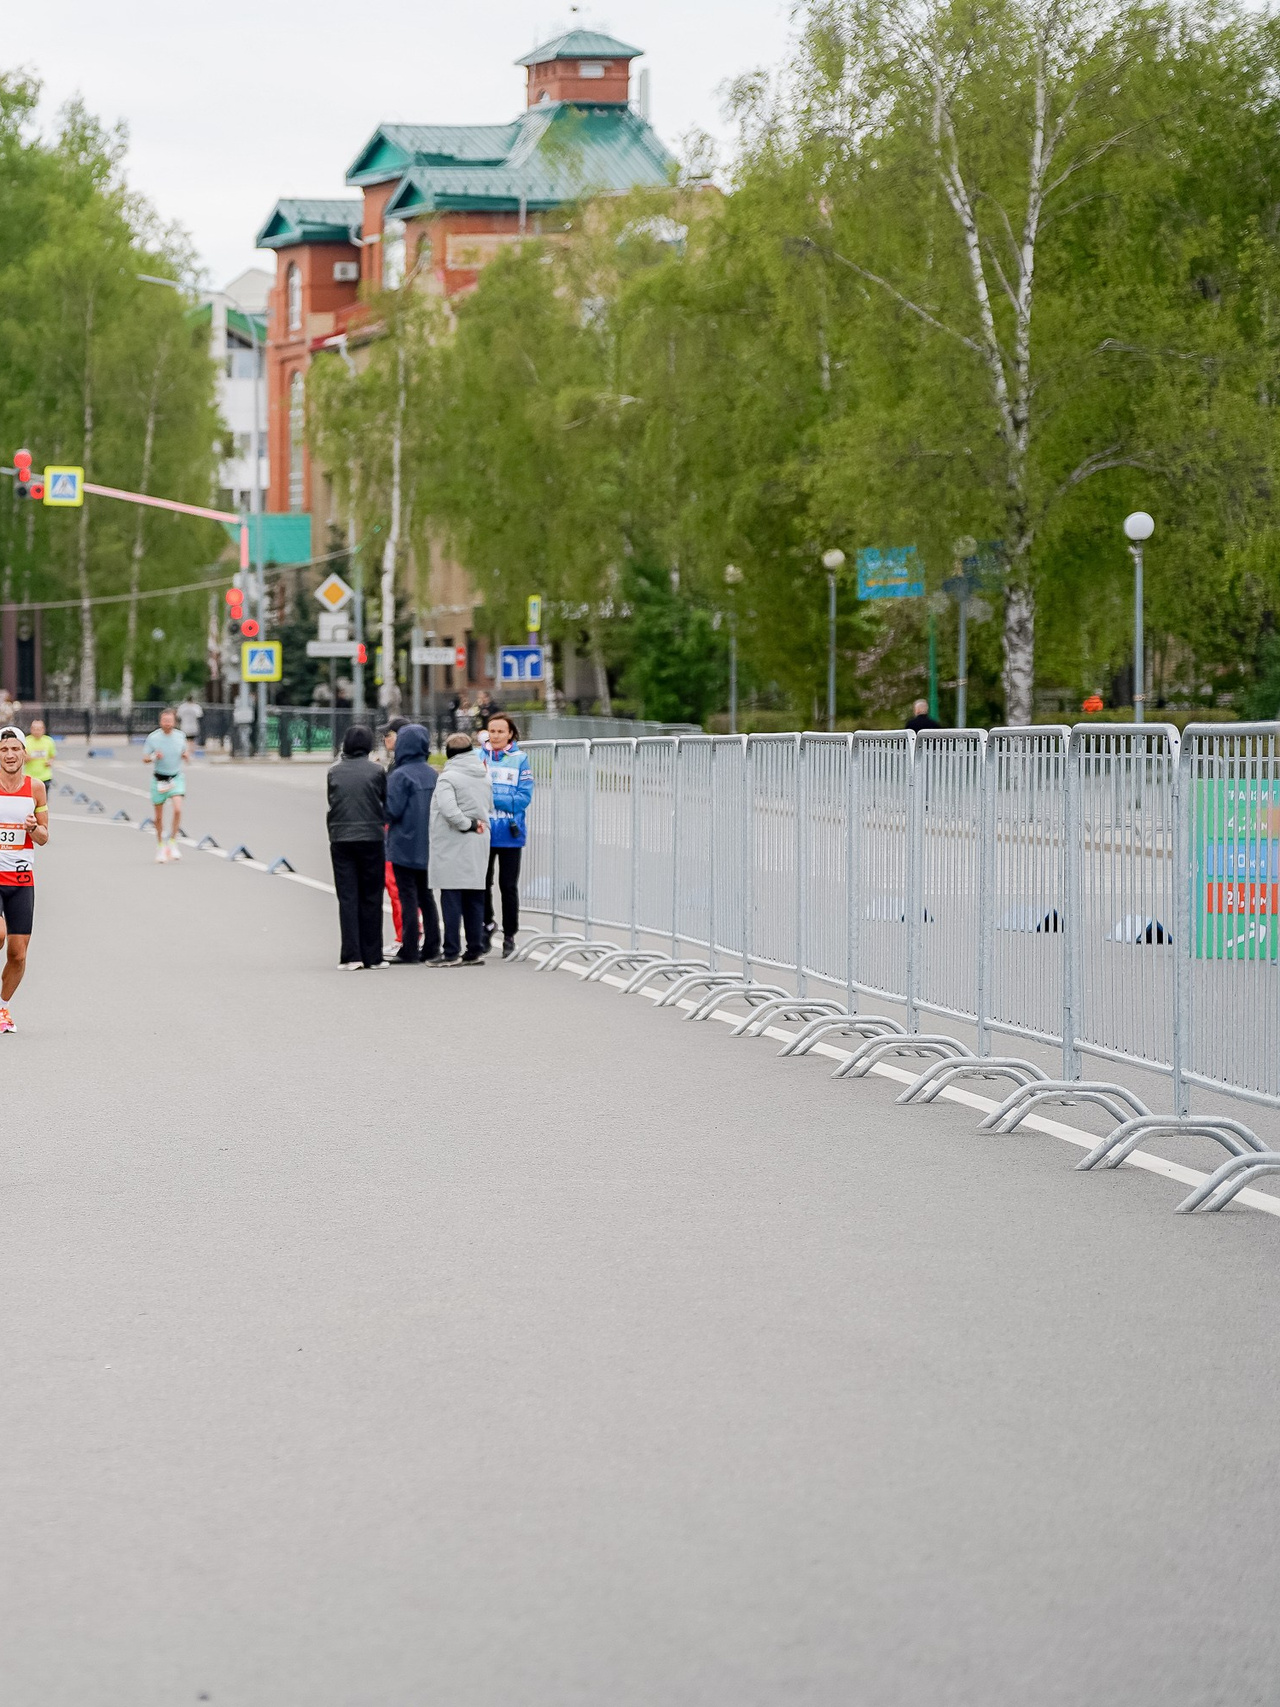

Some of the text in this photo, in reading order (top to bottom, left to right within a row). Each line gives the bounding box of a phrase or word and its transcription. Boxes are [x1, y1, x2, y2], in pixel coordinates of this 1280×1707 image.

[1223, 790, 1276, 801] РАЗИТ
[0, 831, 15, 842] 33
[1229, 853, 1246, 868] 10
[1227, 890, 1248, 908] 21,
